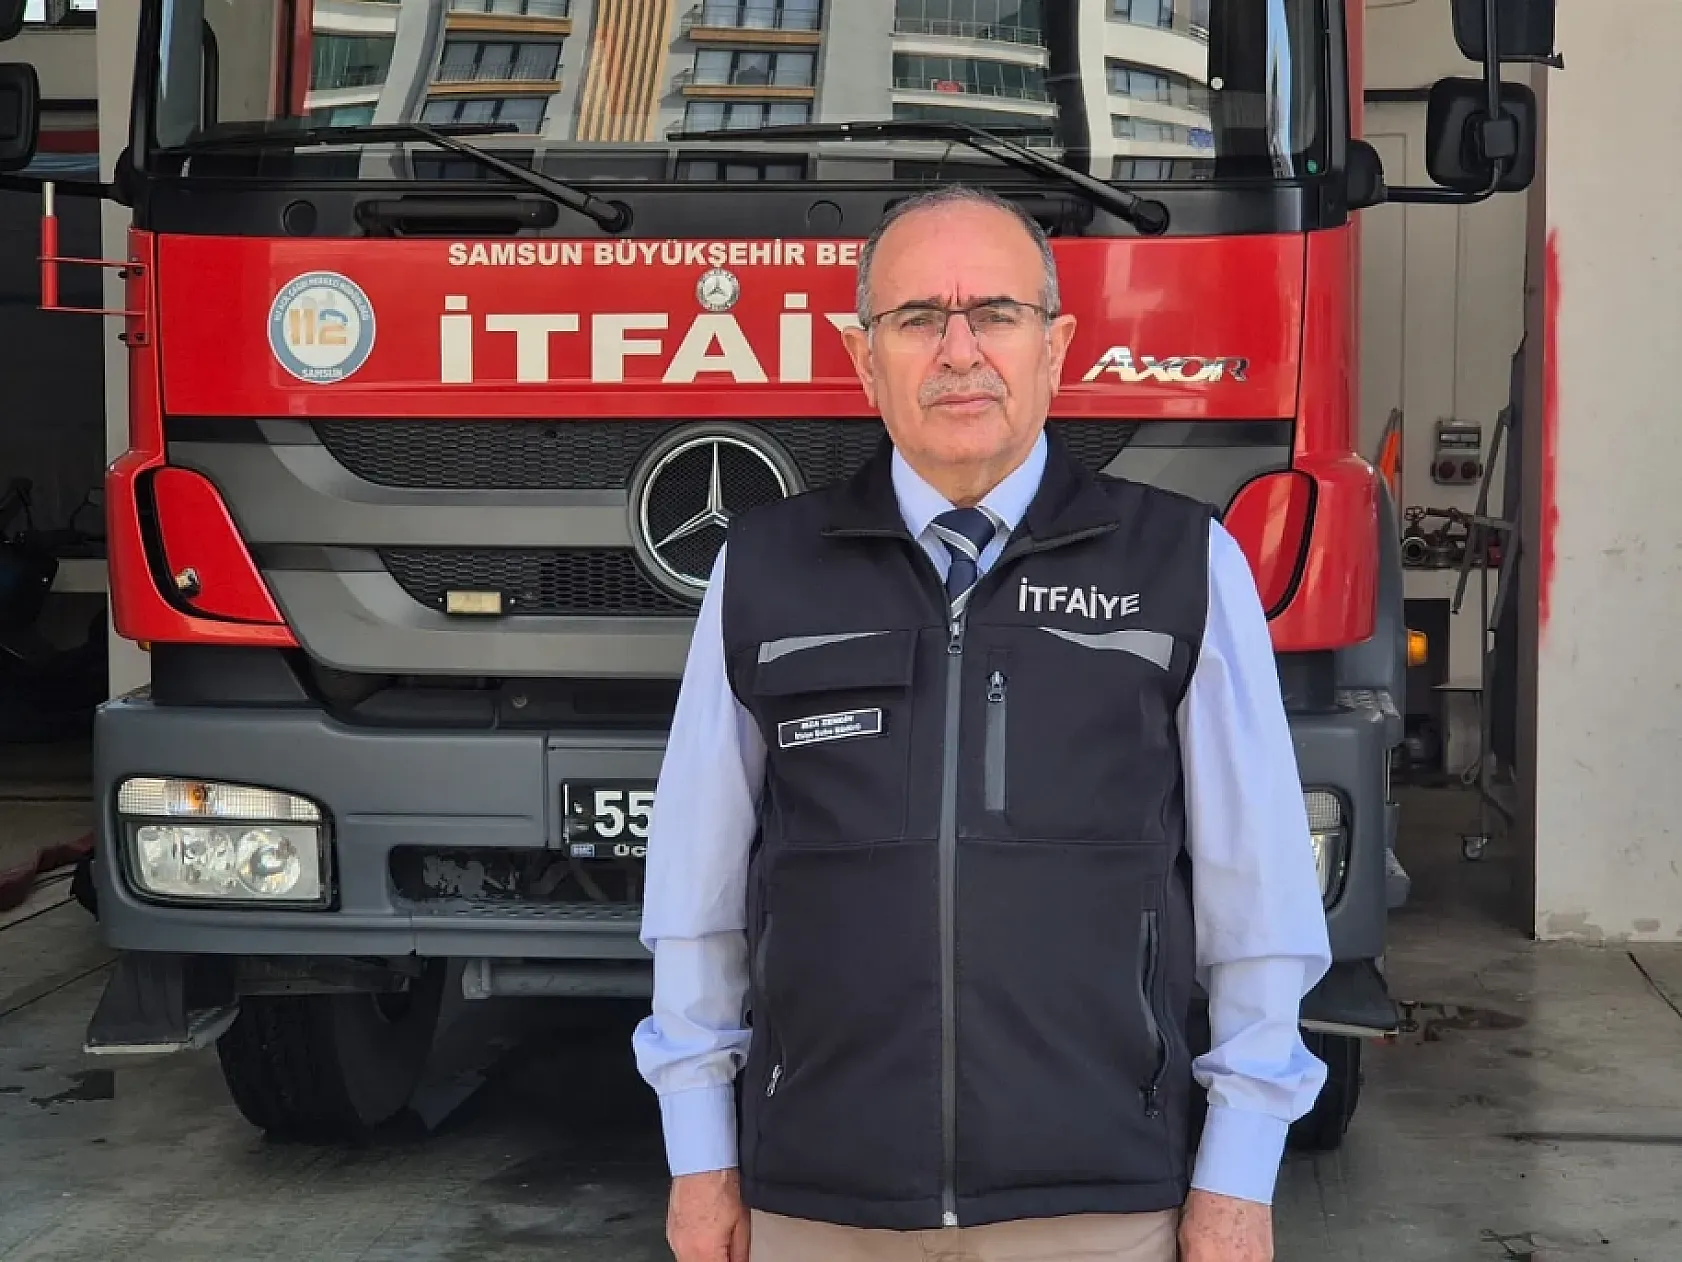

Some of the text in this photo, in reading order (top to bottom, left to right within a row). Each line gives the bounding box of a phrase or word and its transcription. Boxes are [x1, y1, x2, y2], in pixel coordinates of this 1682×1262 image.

[448, 238, 867, 269] SAMSUN BÜYÜKŞEHİR BE
[288, 308, 349, 346] 112
[1018, 576, 1140, 621] İTFAİYE
[594, 790, 655, 837] 55
